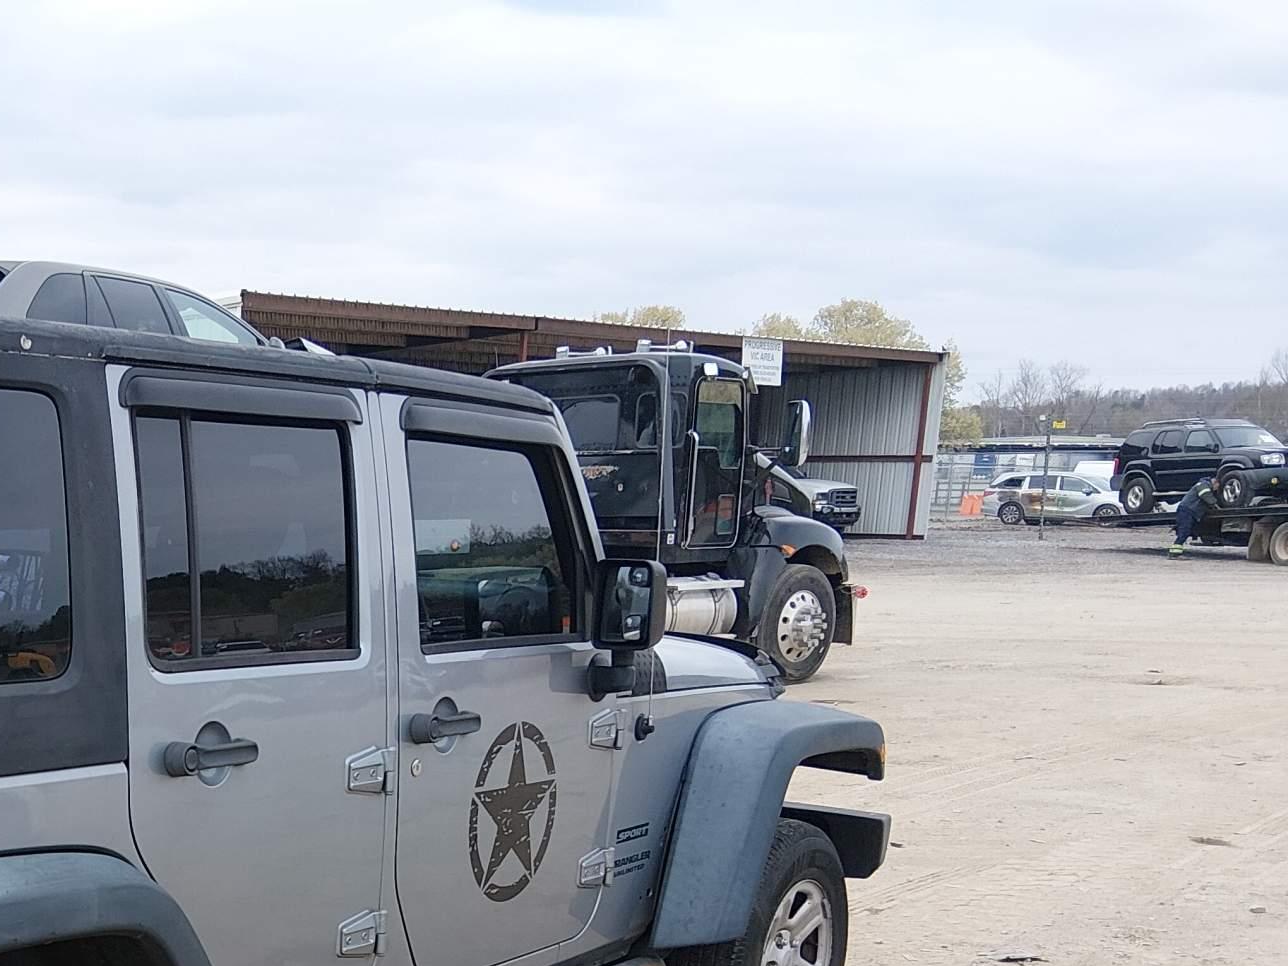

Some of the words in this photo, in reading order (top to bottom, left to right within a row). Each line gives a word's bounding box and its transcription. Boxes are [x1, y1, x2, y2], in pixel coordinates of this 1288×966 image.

[744, 340, 781, 351] PROGRESSIVE
[760, 352, 775, 361] AREA
[617, 825, 648, 842] SPORT
[613, 850, 650, 868] RANGLER
